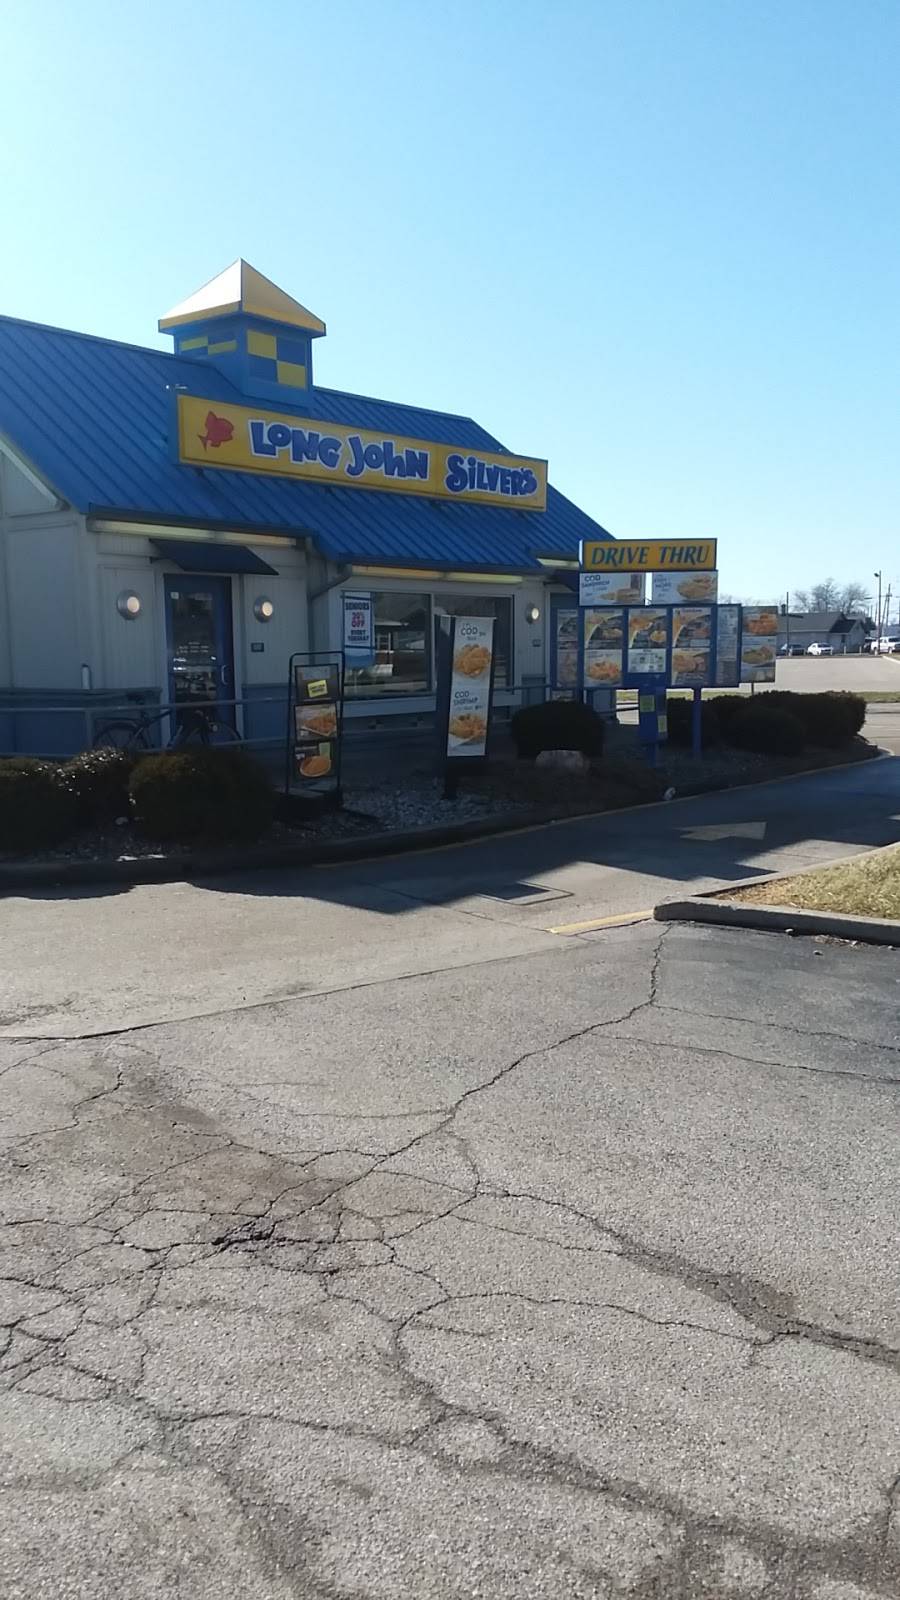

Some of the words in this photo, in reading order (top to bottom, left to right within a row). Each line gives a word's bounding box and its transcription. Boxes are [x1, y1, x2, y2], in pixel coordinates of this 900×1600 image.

[249, 419, 342, 468] LONG
[591, 546, 650, 566] DRIVE
[660, 545, 710, 565] THRU
[584, 574, 601, 582] COD
[345, 602, 370, 610] SENIORS
[351, 619, 365, 628] OFF
[461, 627, 478, 636] COD
[454, 690, 470, 699] COD
